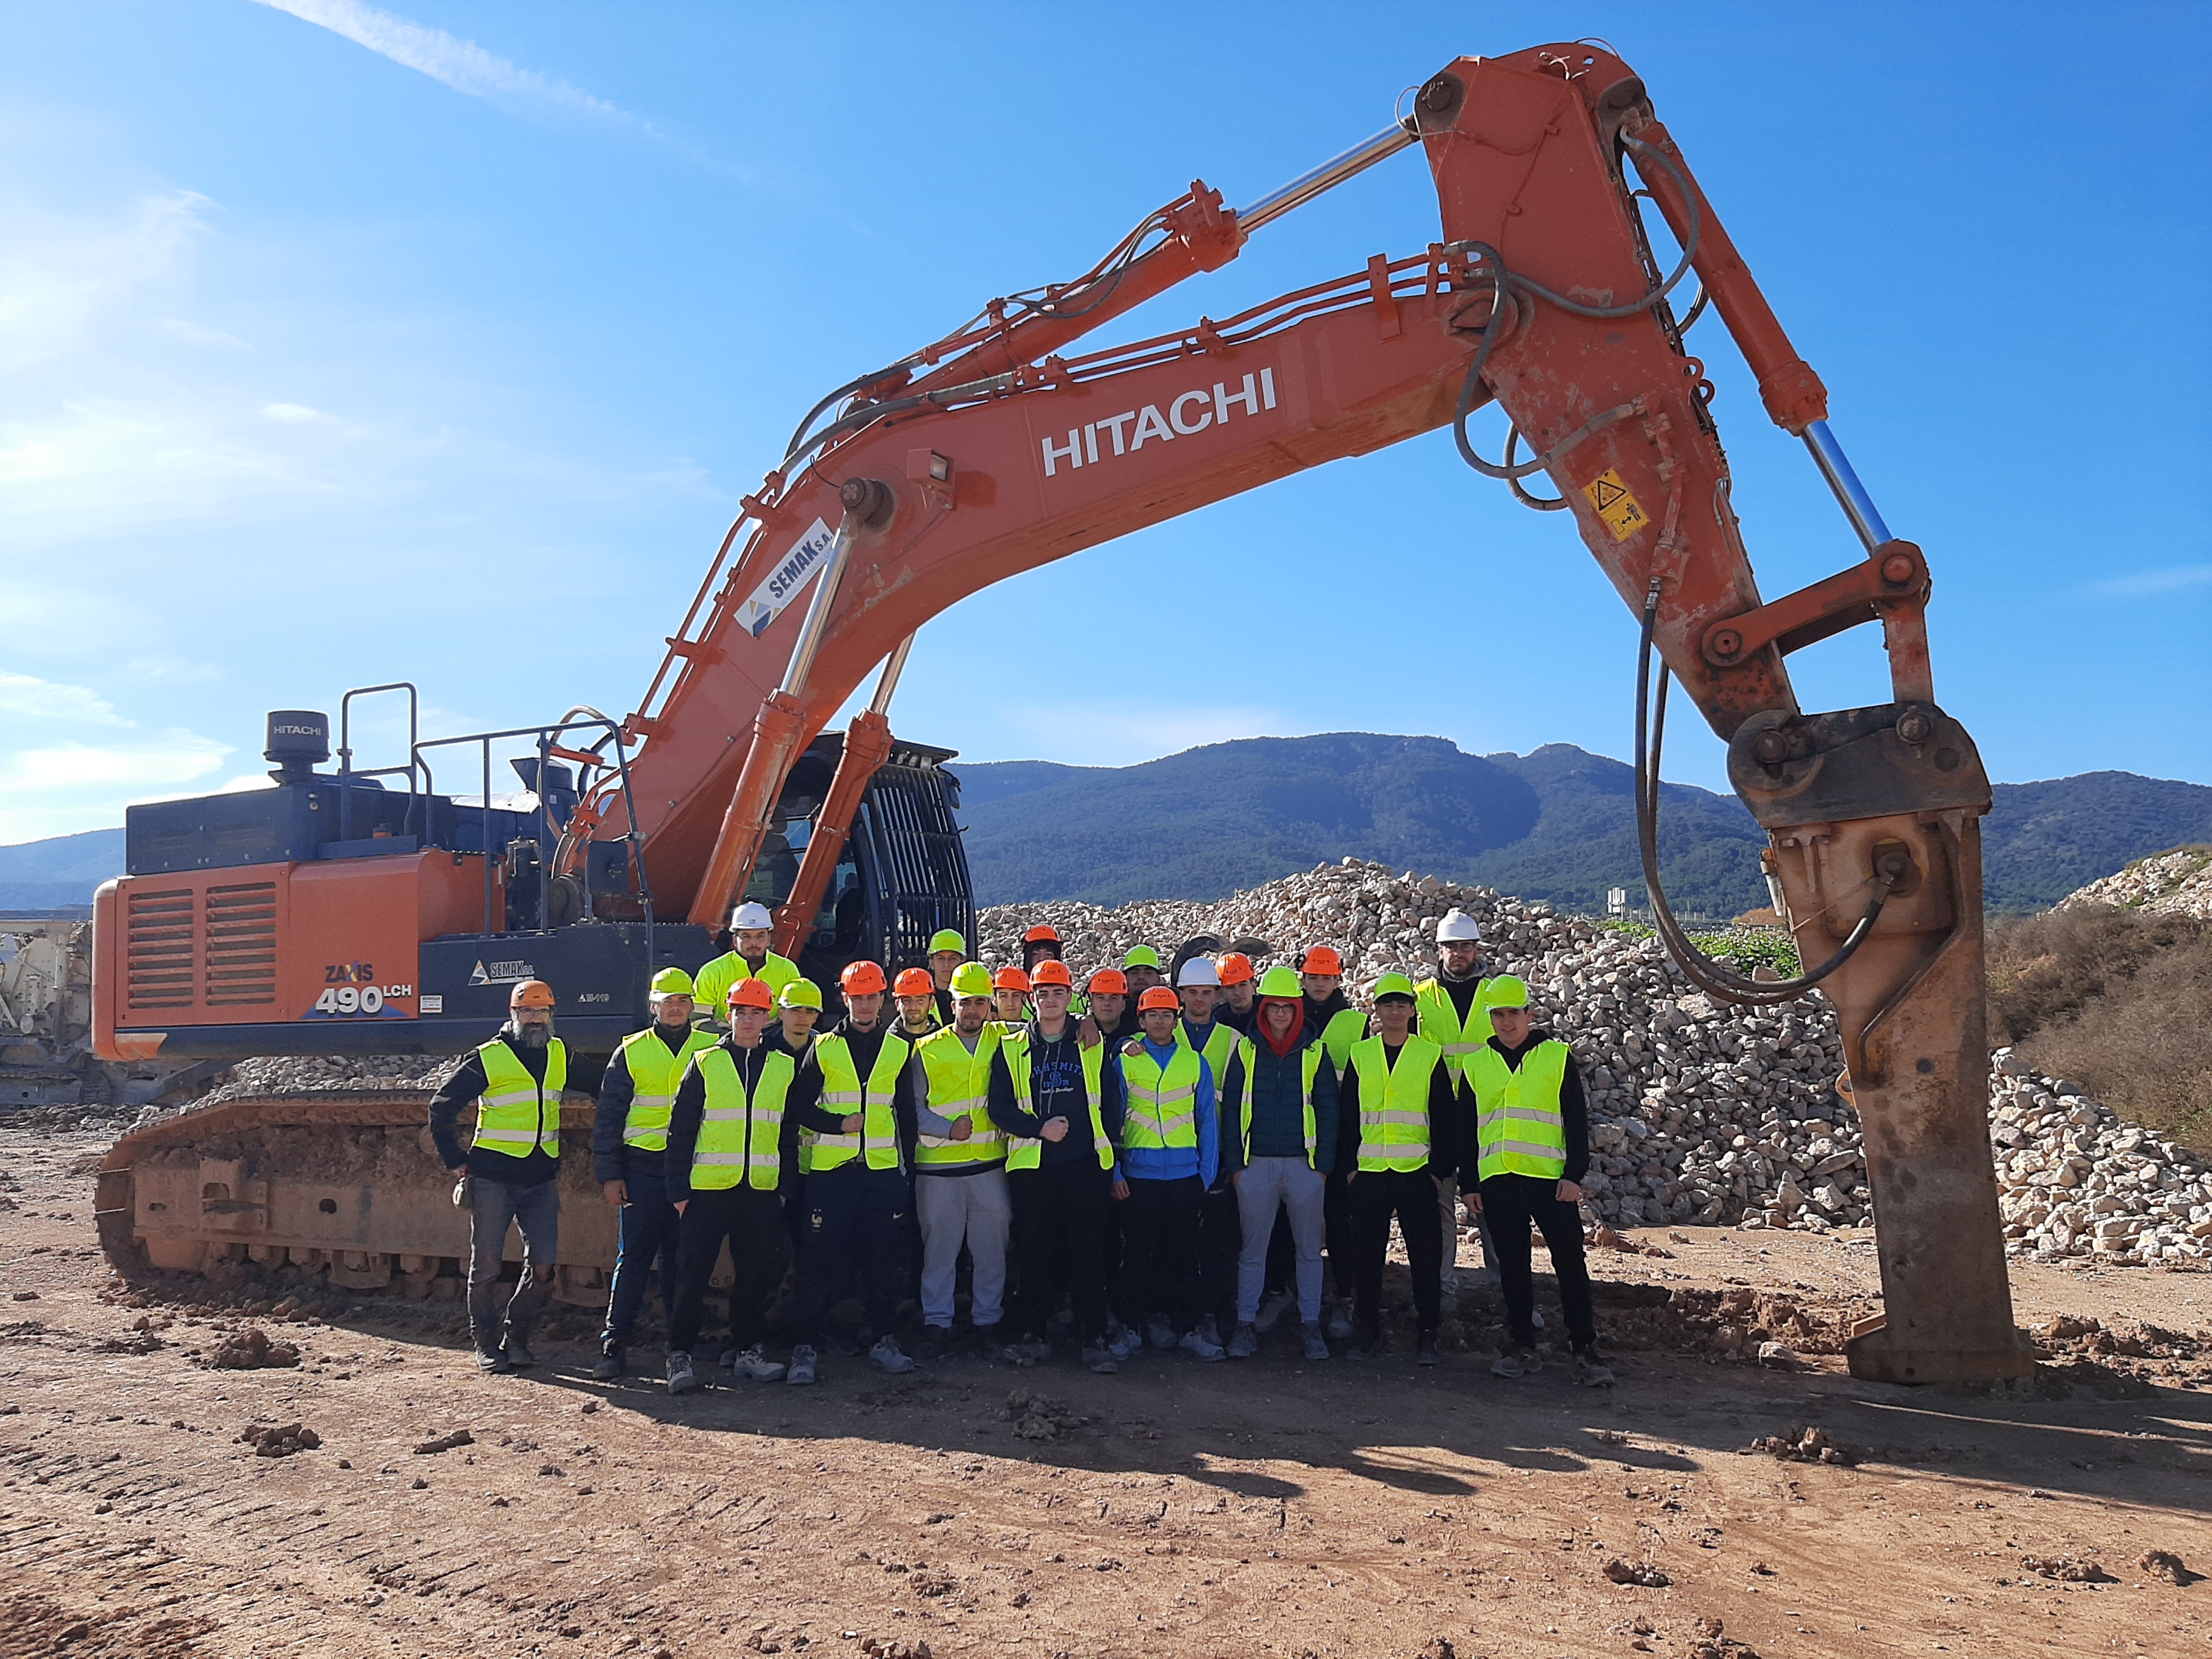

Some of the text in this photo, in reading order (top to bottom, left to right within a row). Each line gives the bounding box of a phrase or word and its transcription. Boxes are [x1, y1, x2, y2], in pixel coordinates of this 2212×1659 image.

[1042, 367, 1276, 477] HITACHI
[769, 540, 819, 599] SEMAK
[274, 726, 321, 736] HITACHI
[325, 961, 374, 983] ZAXIS
[491, 961, 524, 978] SEMAK
[315, 984, 412, 1014] 490 LCH
